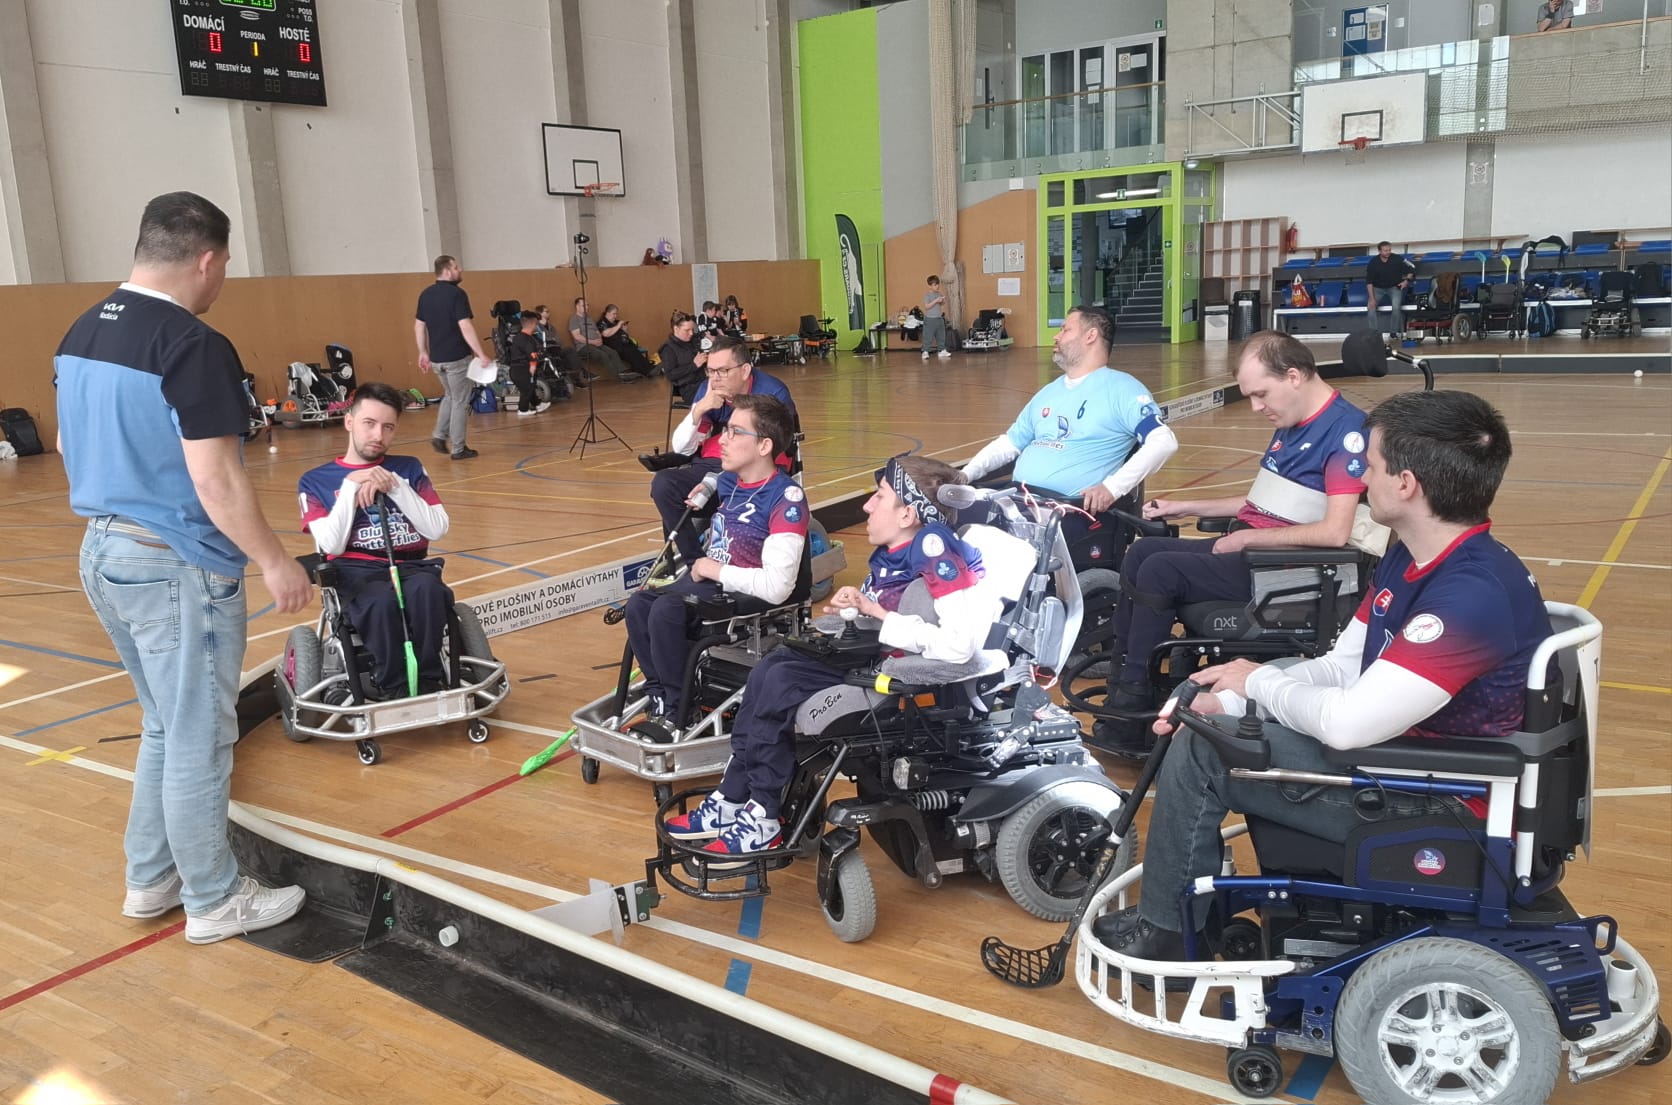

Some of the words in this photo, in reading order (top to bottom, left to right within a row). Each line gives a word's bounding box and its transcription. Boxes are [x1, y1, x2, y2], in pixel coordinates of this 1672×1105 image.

[183, 14, 225, 31] DOMÁCÍ
[209, 32, 221, 52] 0
[240, 30, 266, 41] PERIODA
[279, 26, 311, 42] HOSTÉ
[253, 41, 259, 57] 1
[299, 43, 310, 62] 0
[189, 59, 207, 70] HRÁČ
[215, 62, 239, 72] TRESTNÝ
[240, 63, 252, 73] ČAS
[1077, 399, 1088, 419] 6
[737, 502, 757, 524] 2
[496, 590, 537, 610] PLOŠINY
[539, 588, 546, 599] A
[547, 576, 585, 596] DOMÁCÍ
[585, 568, 620, 586] VÝTAHY
[500, 601, 544, 623] IMOBILNÍ
[545, 592, 577, 610] OSOBY
[1213, 615, 1238, 628] nxt
